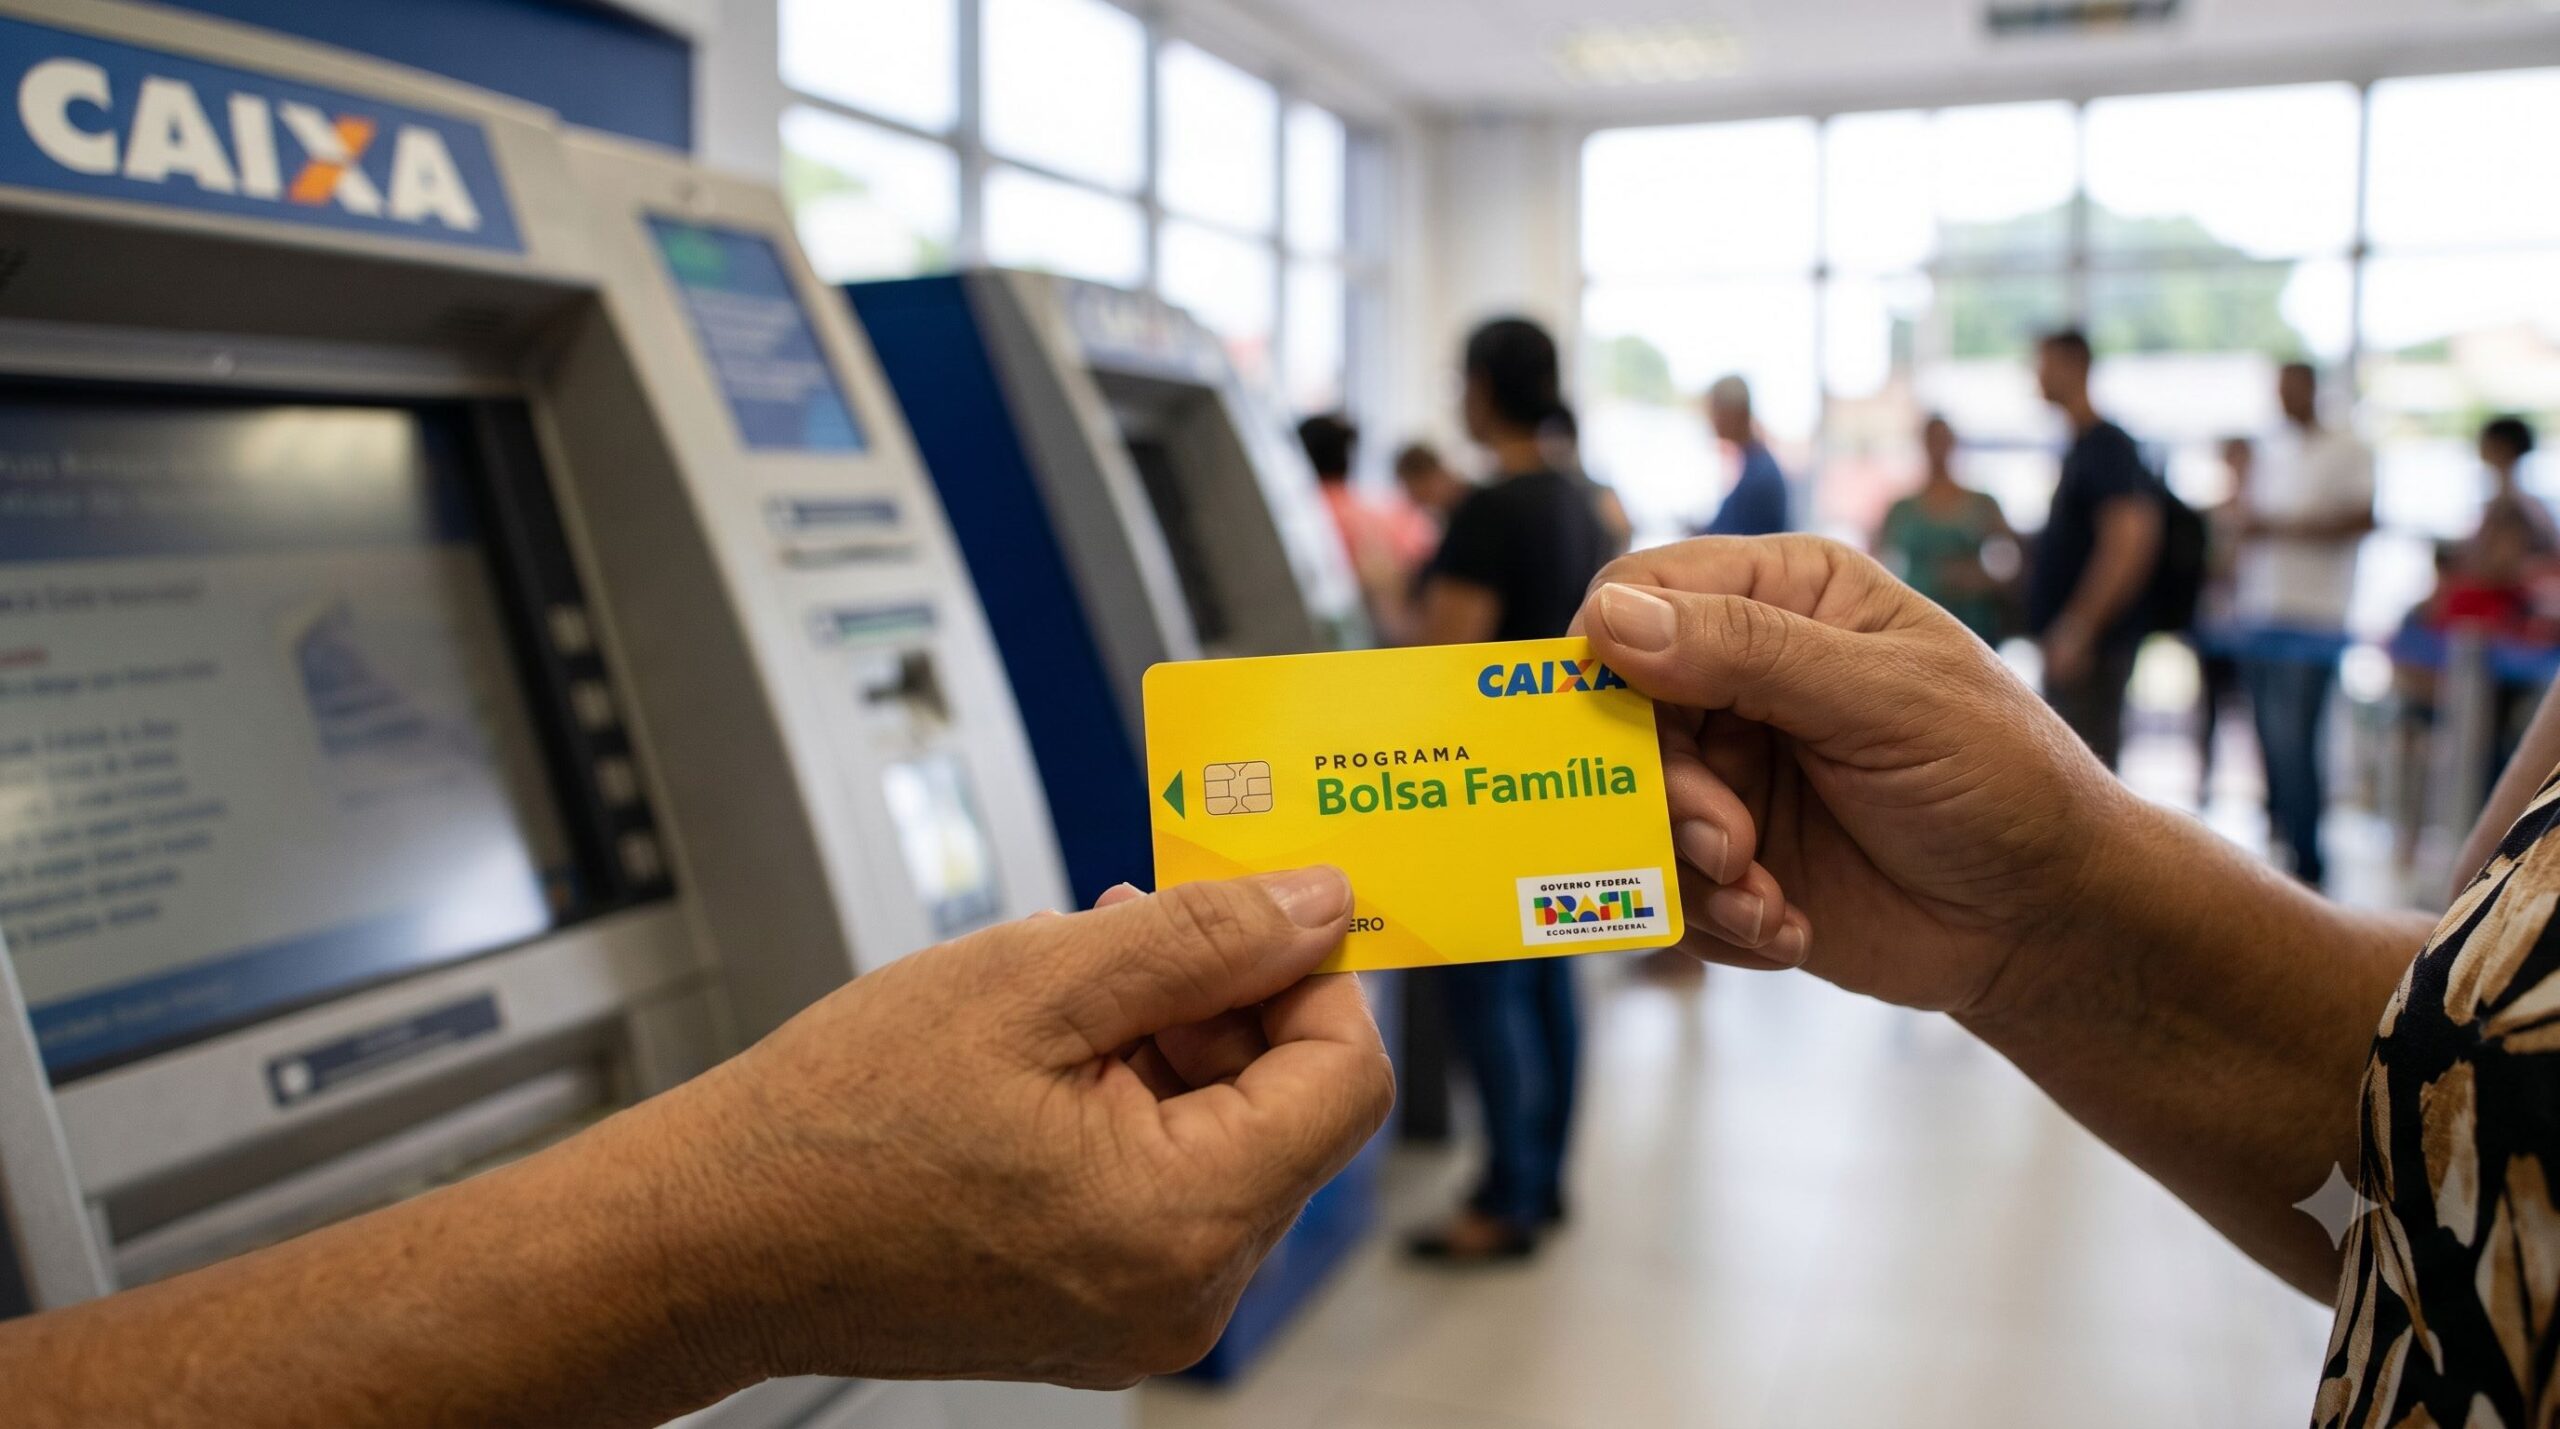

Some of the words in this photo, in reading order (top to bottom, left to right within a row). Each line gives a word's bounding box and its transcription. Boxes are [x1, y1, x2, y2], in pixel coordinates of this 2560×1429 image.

[17, 56, 481, 233] CAIXA
[1477, 659, 1628, 698] CAIXA
[1315, 746, 1470, 770] PROGRAMA
[1317, 772, 1447, 815] Bolsa
[1464, 757, 1637, 805] Família
[1540, 881, 1591, 891] GOVERNO
[1596, 877, 1641, 887] FEDERAL
[1533, 890, 1654, 926] BRASIL
[1607, 923, 1647, 932] FEDERAL
